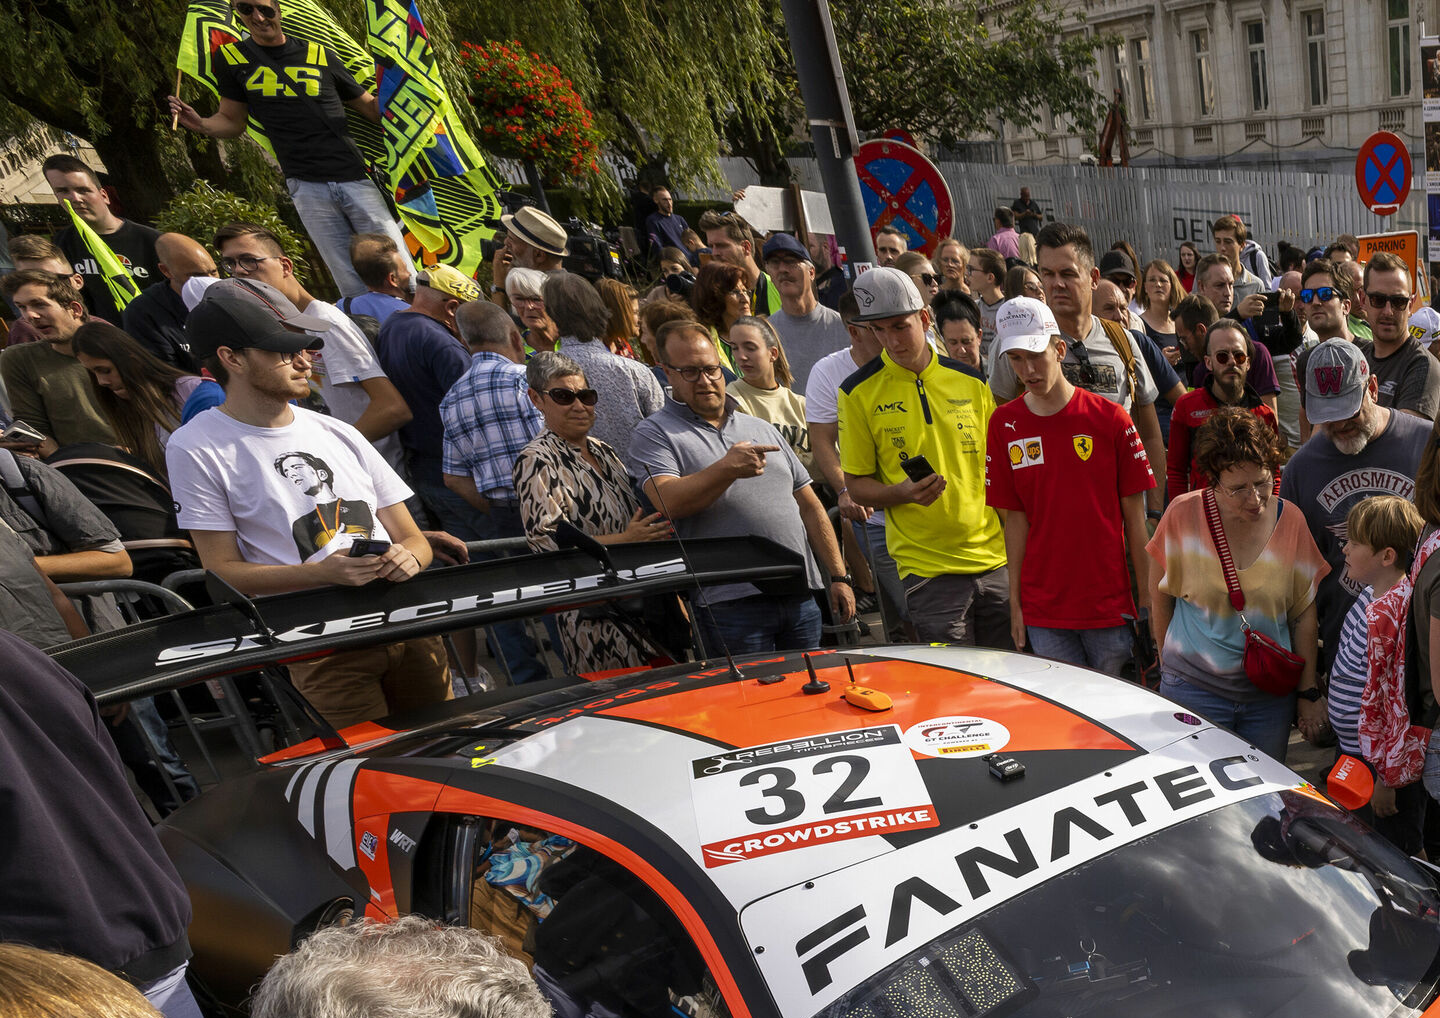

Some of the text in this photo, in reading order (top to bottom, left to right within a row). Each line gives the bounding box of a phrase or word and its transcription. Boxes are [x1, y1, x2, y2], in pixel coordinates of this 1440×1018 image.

[1366, 239, 1406, 252] PARKING
[75, 258, 149, 278] ellse
[450, 280, 481, 298] 46
[1314, 365, 1345, 395] W
[874, 401, 908, 413] AMR
[1027, 444, 1041, 457] ups
[1322, 470, 1416, 508] AEROSMITH
[938, 732, 991, 741] CHALLENGE
[1335, 757, 1357, 782] WRT
[738, 754, 884, 826] 32
[390, 828, 417, 854] WRT
[722, 809, 932, 856] CROWDSTRIKE
[794, 754, 1265, 997] FANATEC
